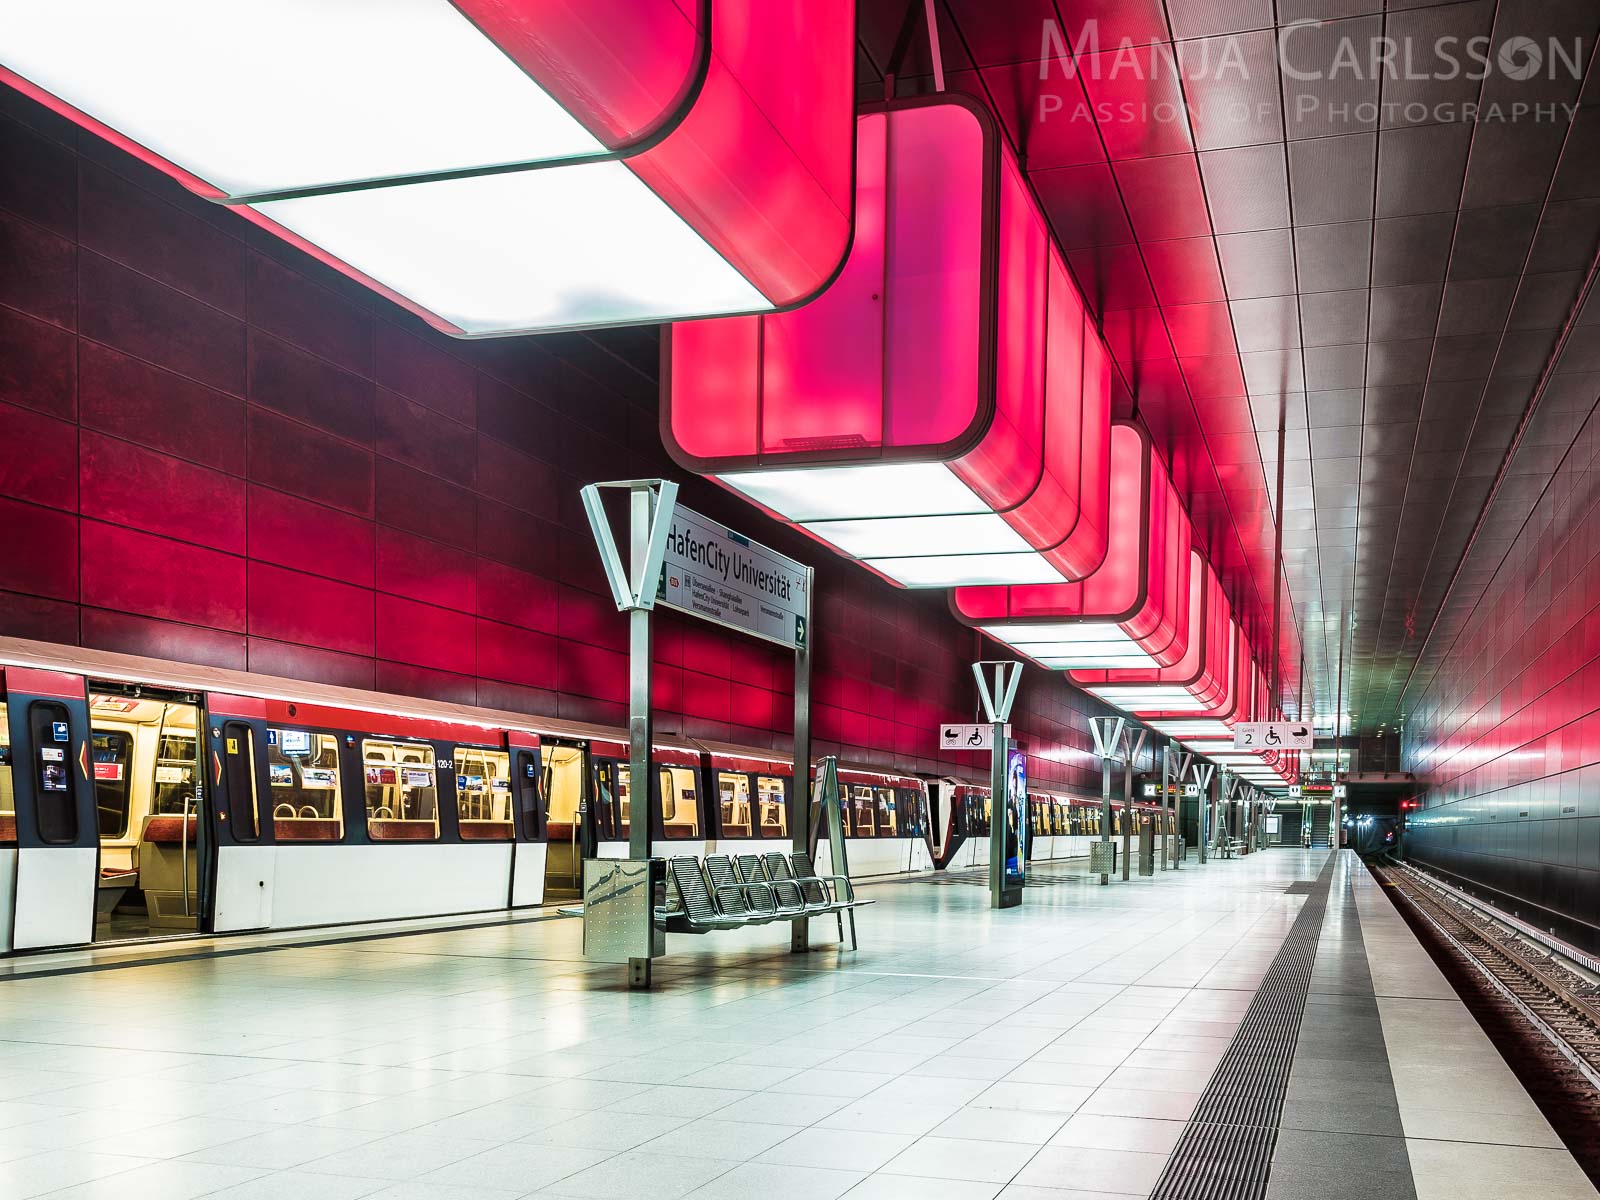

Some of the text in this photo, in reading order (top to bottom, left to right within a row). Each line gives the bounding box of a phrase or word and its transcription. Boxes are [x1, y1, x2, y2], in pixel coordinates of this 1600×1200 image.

[667, 524, 791, 601] HafenCity Universität
[1245, 733, 1252, 744] 2
[437, 759, 453, 769] 120-2
